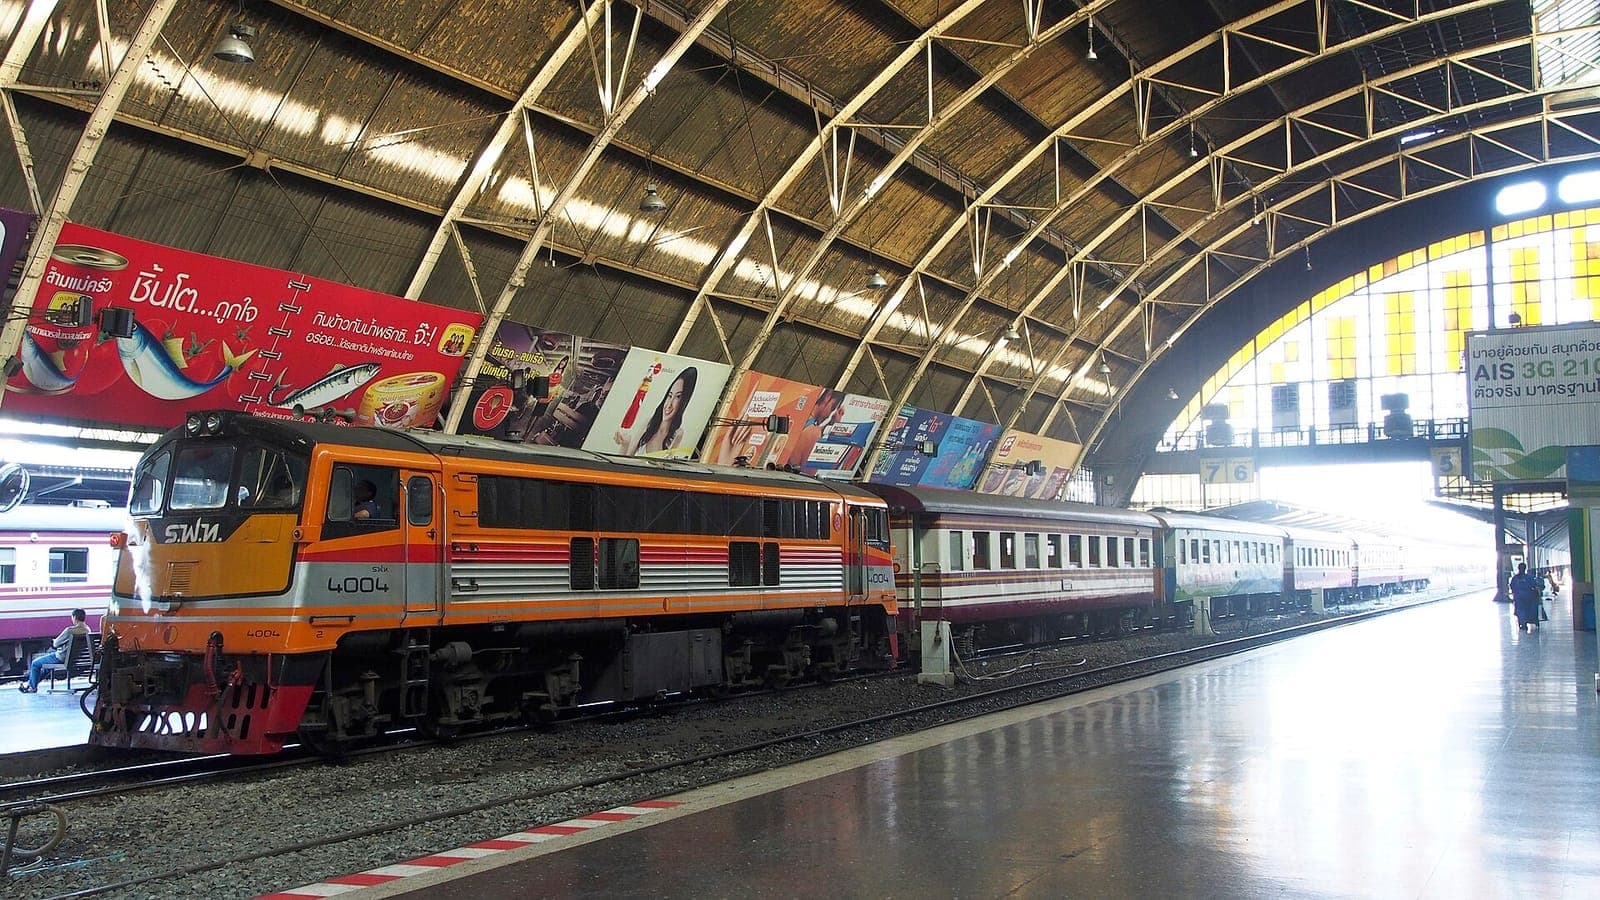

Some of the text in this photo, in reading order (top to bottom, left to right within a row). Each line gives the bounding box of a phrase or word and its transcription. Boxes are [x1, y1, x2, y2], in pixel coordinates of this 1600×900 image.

[1472, 343, 1548, 360] มาอยู่ด้วยกัน
[1474, 362, 1515, 382] AIS
[1522, 360, 1555, 379] 3G
[1474, 384, 1521, 398] ตัวจริง
[1439, 455, 1453, 472] 5
[1206, 464, 1248, 482] 7 6
[327, 576, 389, 593] 4004
[246, 629, 280, 638] 4004
